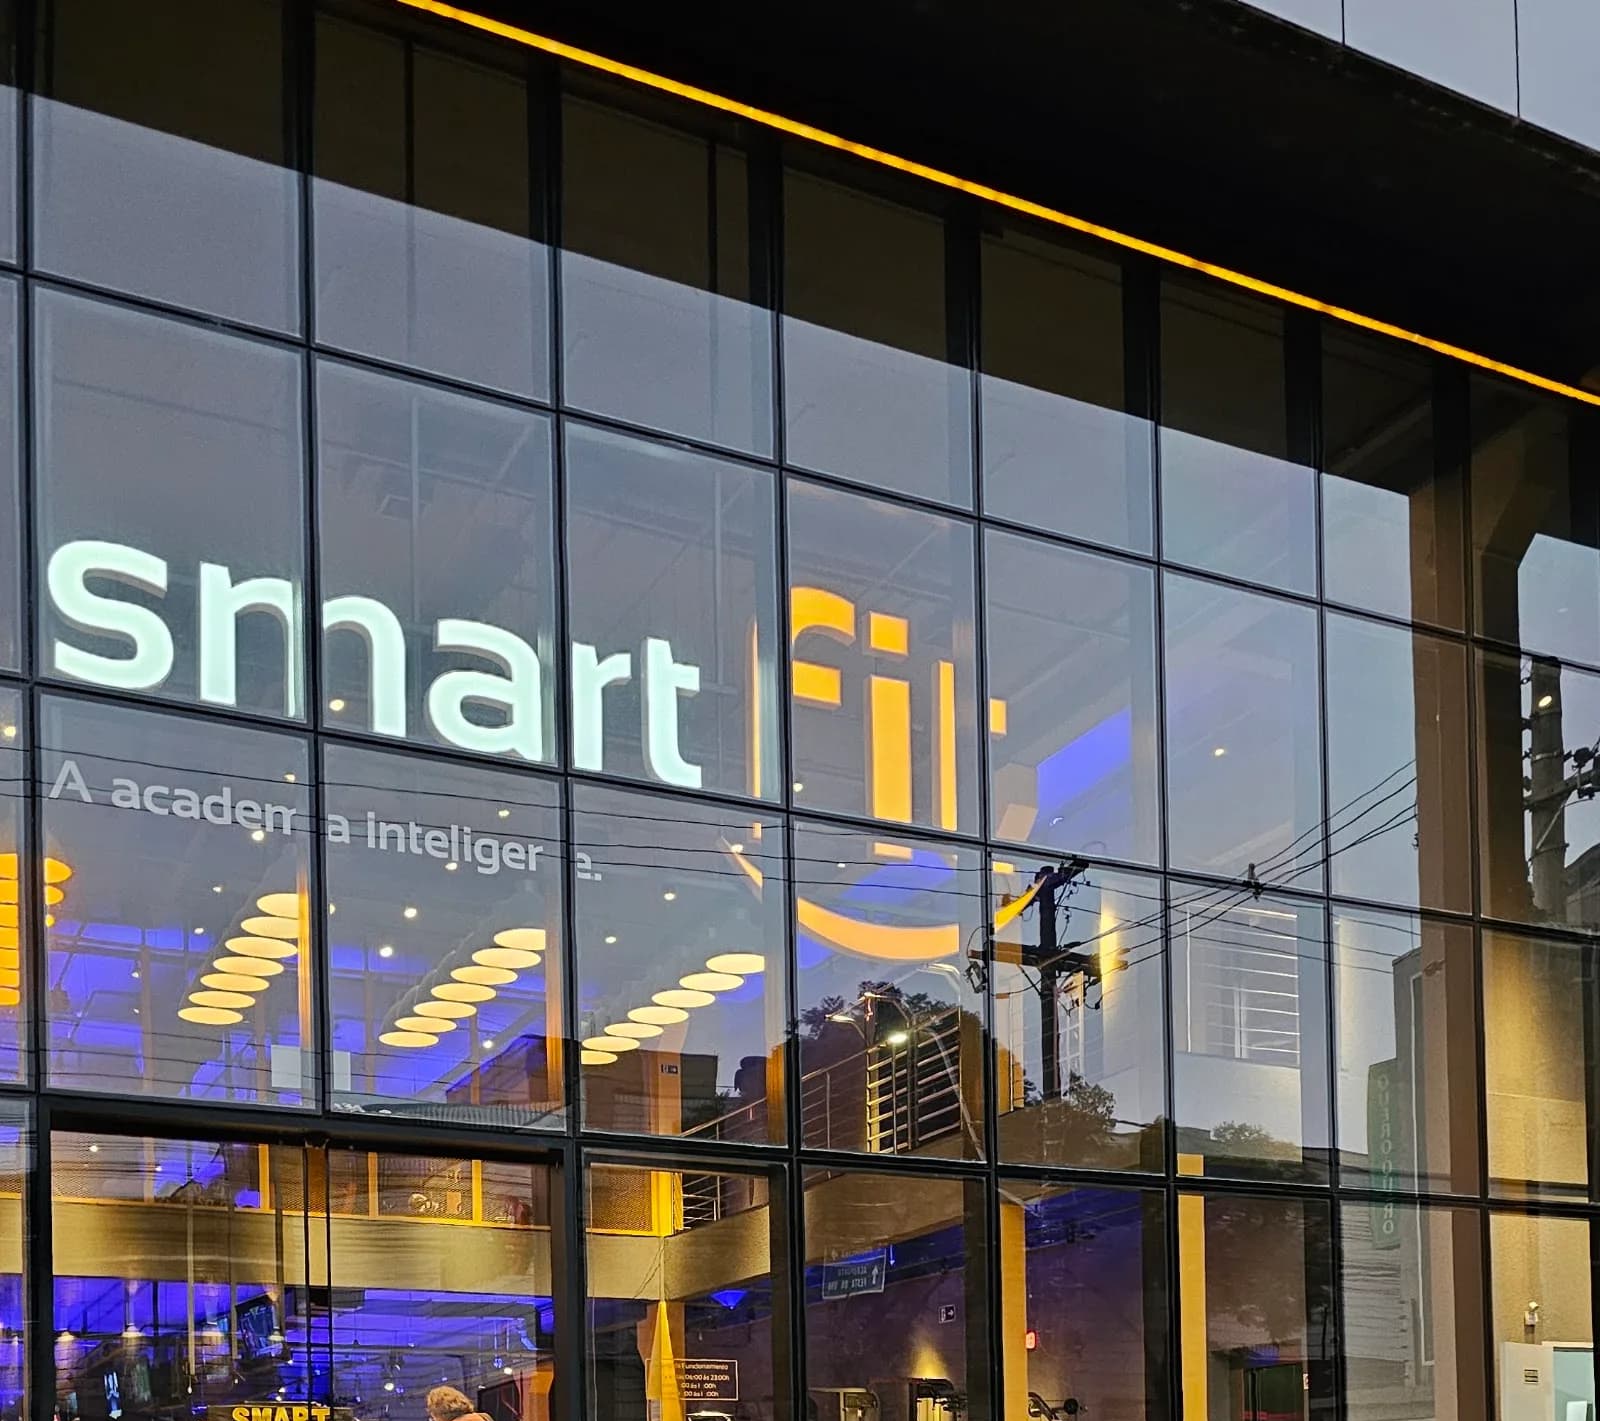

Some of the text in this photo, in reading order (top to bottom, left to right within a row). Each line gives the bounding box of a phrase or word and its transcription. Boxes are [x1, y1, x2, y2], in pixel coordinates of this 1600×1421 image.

[47, 539, 701, 789] smart
[48, 759, 602, 882] A academa inteligene.
